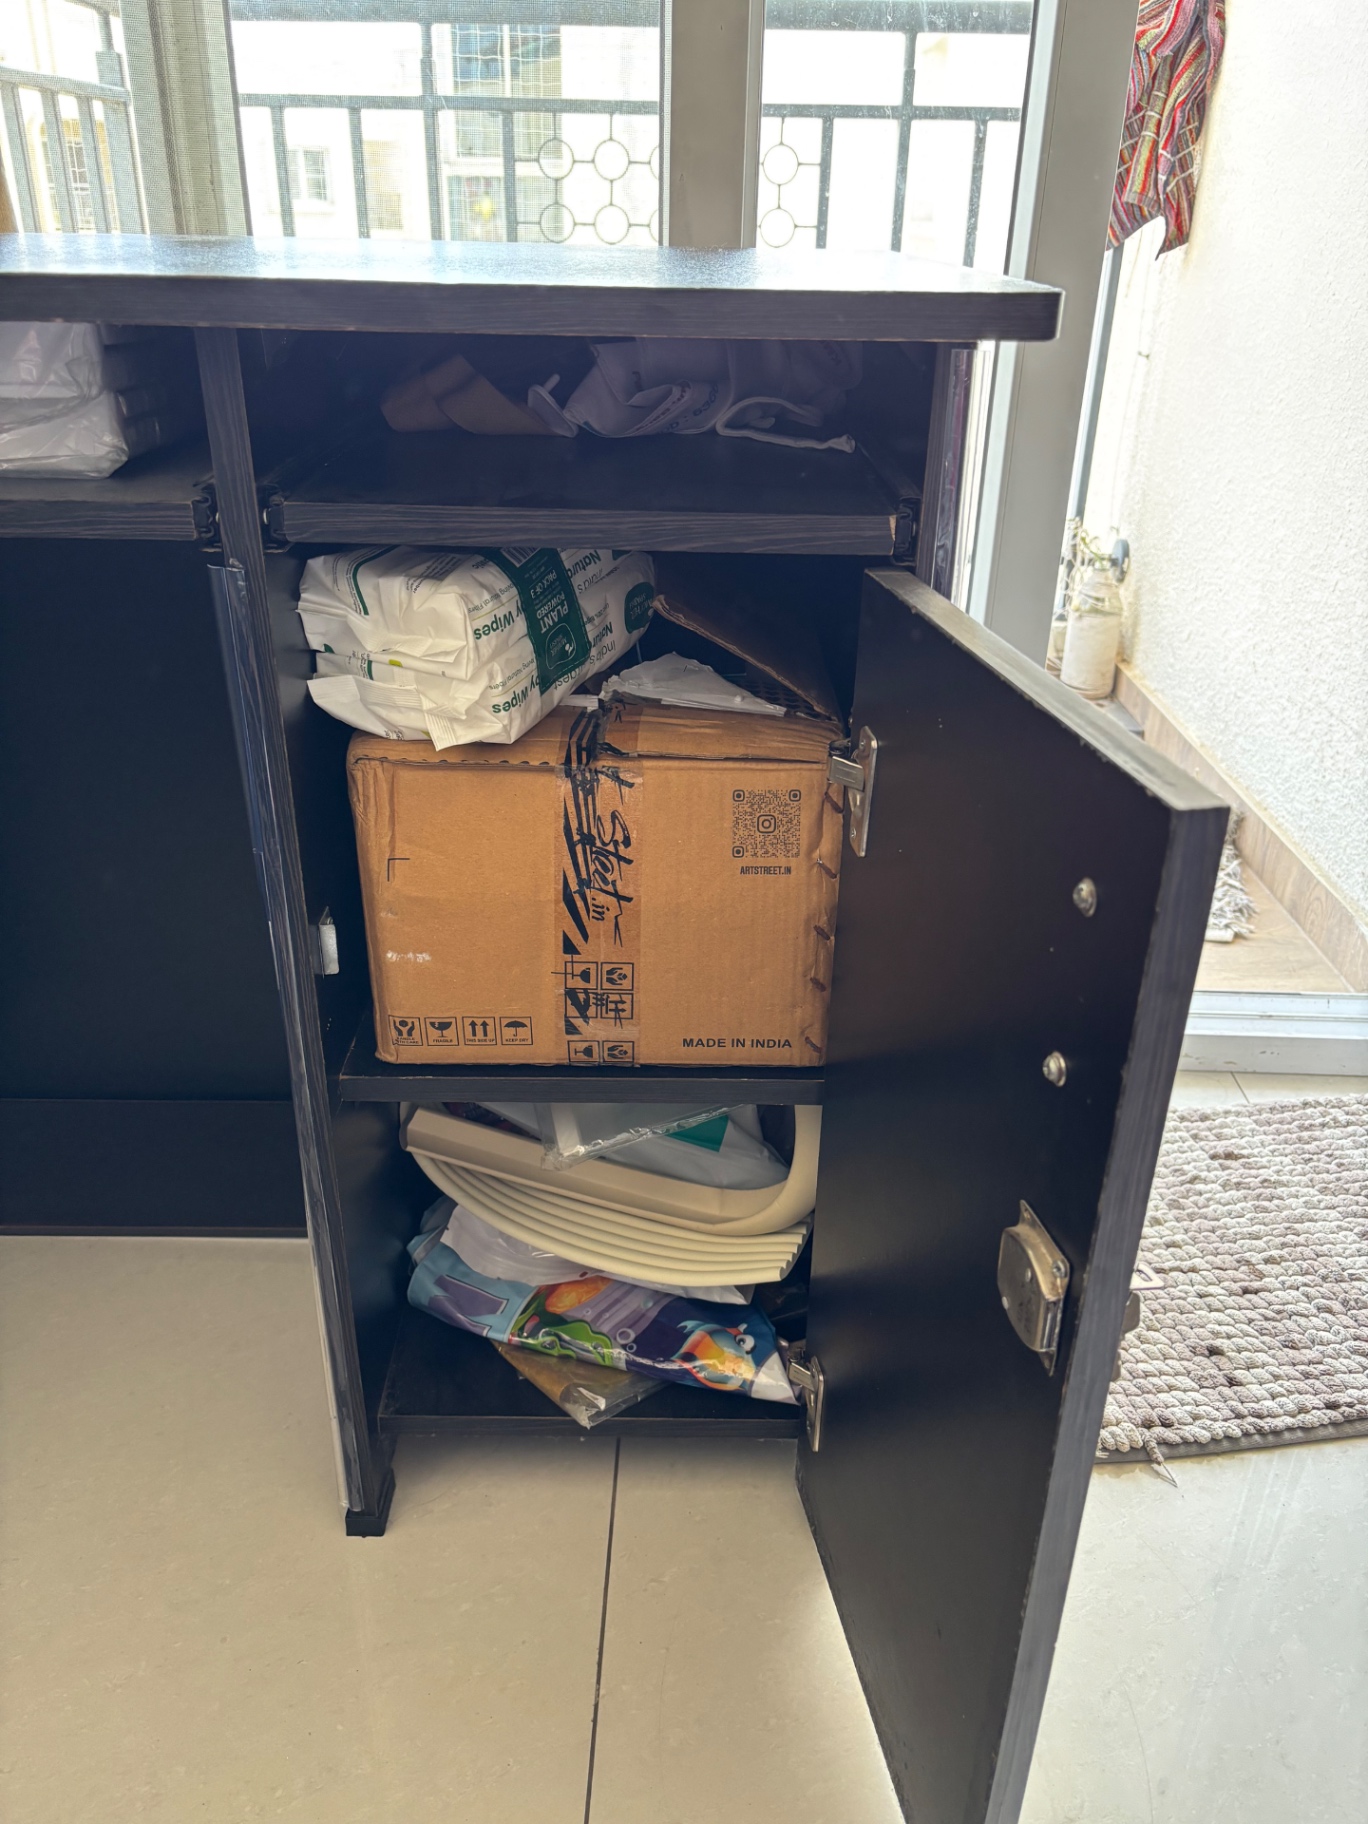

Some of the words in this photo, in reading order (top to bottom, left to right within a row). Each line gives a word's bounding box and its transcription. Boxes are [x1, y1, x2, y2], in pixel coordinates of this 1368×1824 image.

[542, 569, 558, 587] PACK
[536, 591, 566, 619] POWERED
[540, 601, 569, 634] PLANT
[473, 610, 515, 641] Wipes
[492, 686, 529, 714] Wipes
[739, 865, 793, 876] ARTSTREET.IN
[682, 1038, 727, 1049] MADE
[731, 1038, 746, 1049] IN
[750, 1038, 792, 1049] INDIA
